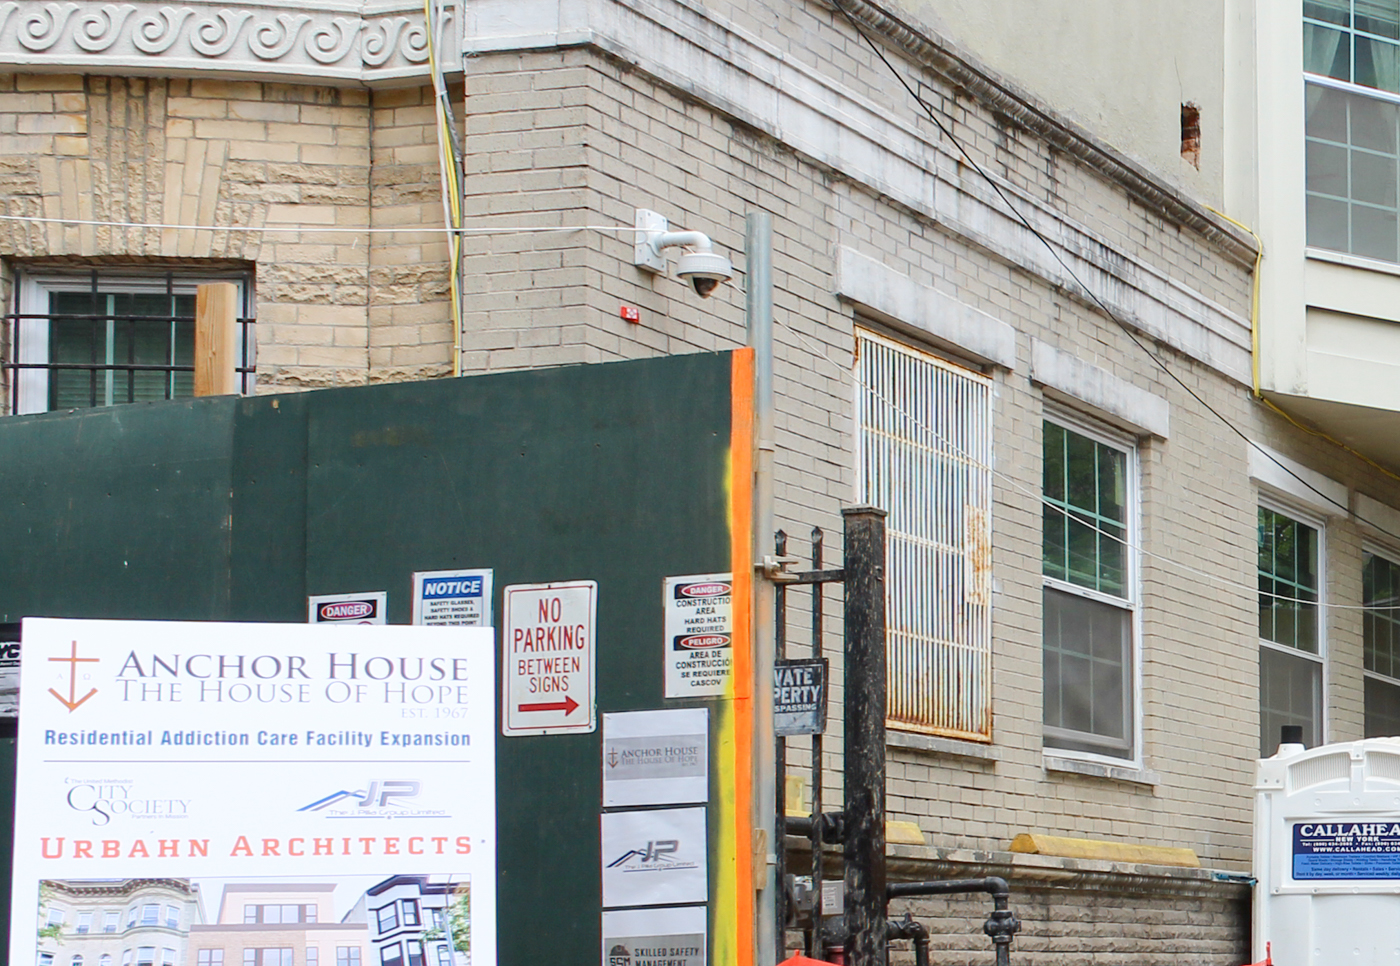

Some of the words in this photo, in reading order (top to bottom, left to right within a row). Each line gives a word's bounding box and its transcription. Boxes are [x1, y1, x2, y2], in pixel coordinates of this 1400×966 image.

[425, 580, 481, 595] NOTICE
[690, 585, 724, 595] DANGER
[676, 597, 731, 607] CONSTRUCTIO
[326, 604, 367, 617] DANGER
[538, 597, 561, 623] NO
[696, 607, 716, 615] AREA
[684, 617, 705, 625] HARD
[686, 625, 724, 633] REQUIRED
[514, 624, 585, 653] PARKING
[688, 637, 723, 646] PELIGRO
[689, 651, 709, 659] AREA
[711, 650, 722, 658] DE
[117, 650, 312, 679] ANCHOR
[327, 652, 468, 681] HOUSE
[518, 656, 580, 675] BETWEEN
[774, 667, 813, 686] VATE
[529, 675, 569, 693] SIGNS
[116, 679, 182, 702] THE
[199, 680, 311, 703] HOUSE
[325, 680, 368, 703] OF
[384, 682, 468, 704] HOPE
[774, 685, 820, 704] PERTY
[401, 707, 428, 718] EST.
[435, 707, 468, 719] 1967
[774, 704, 817, 712] SPASSING
[45, 730, 152, 745] Residential
[160, 730, 249, 745] Addiction
[257, 730, 298, 745] Care
[306, 730, 373, 747] Facility
[381, 731, 470, 747] Expansion
[621, 748, 662, 758] ANCHOR
[664, 746, 698, 756] HOUSE
[622, 757, 634, 765] THE
[637, 756, 662, 765] HOUSE
[67, 784, 133, 812] CITY
[92, 799, 192, 826] SOCIETY
[40, 837, 210, 859] URBAHN
[230, 836, 472, 857] ARCHITECTS
[634, 947, 667, 957] SKILLED
[670, 947, 699, 956] SAFETY
